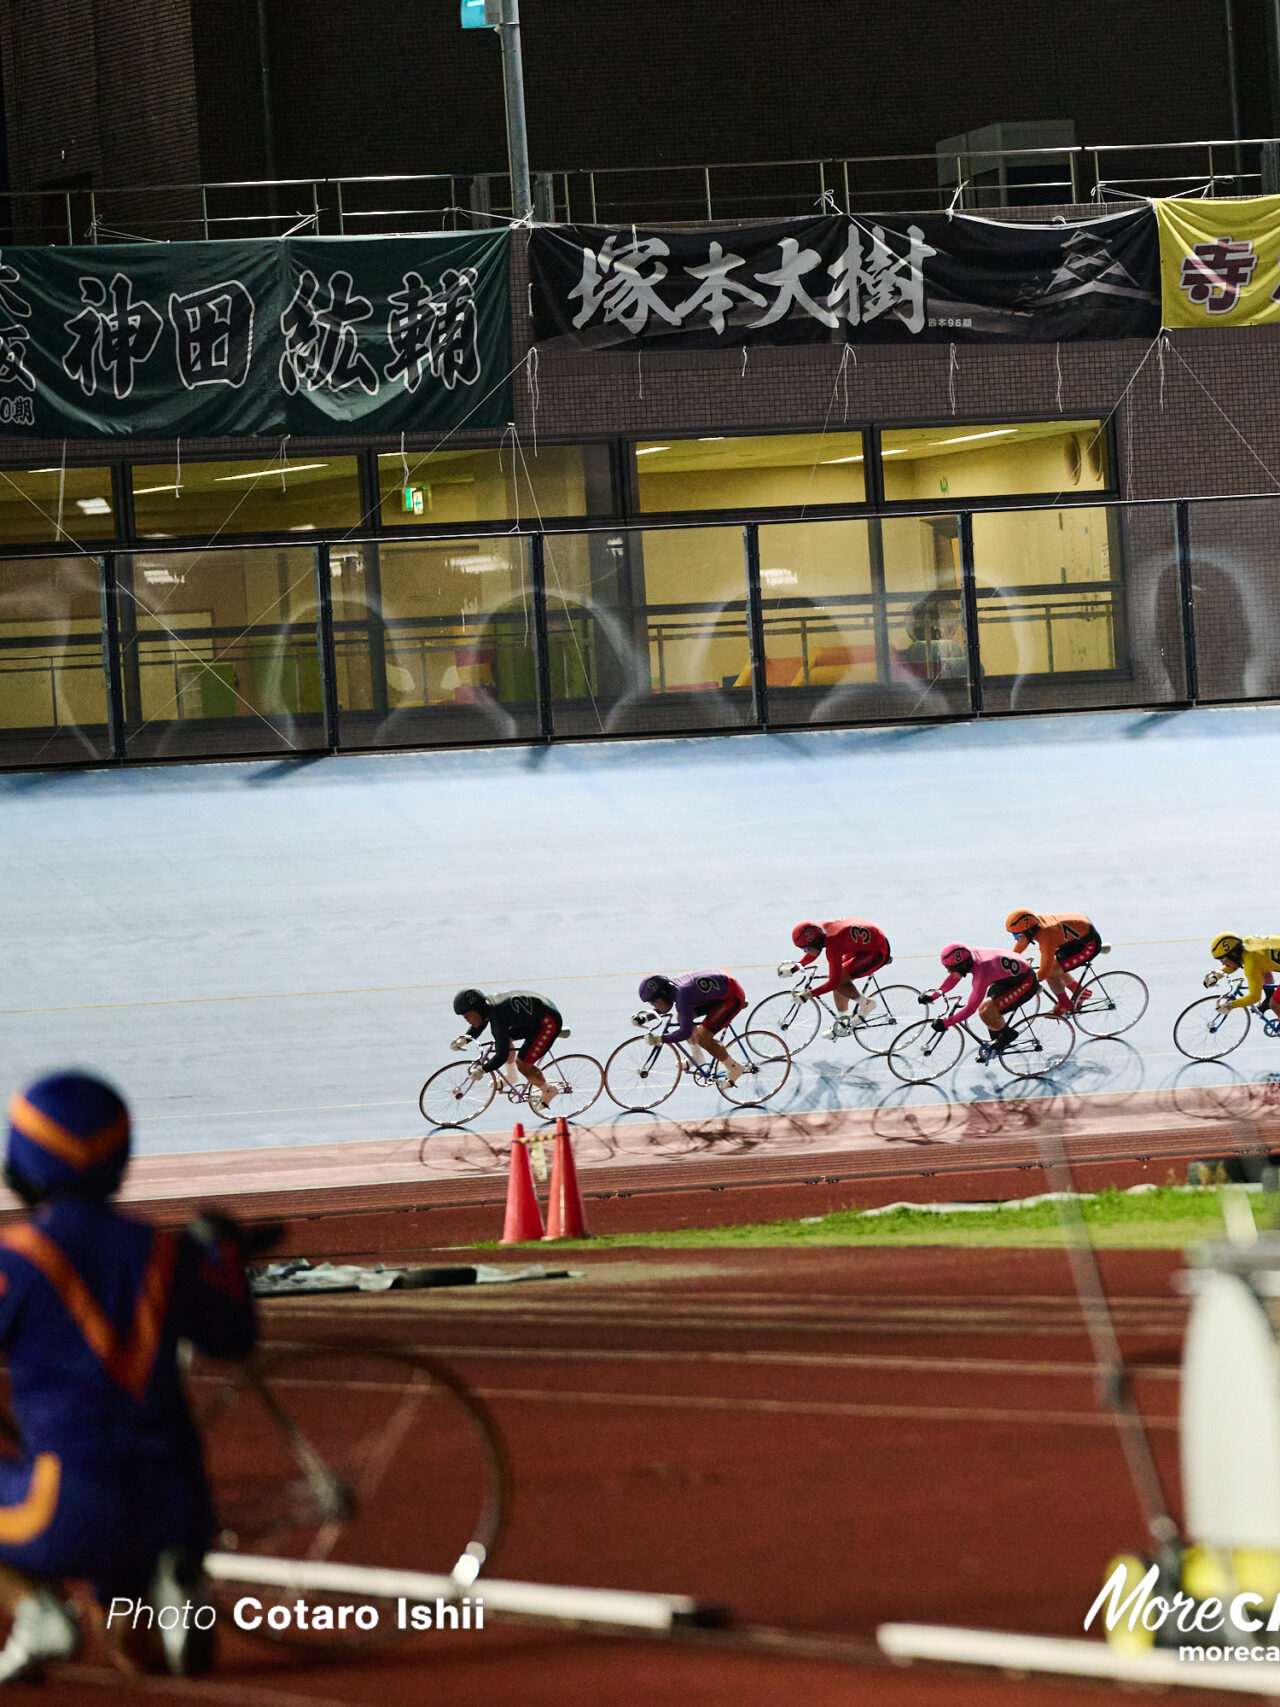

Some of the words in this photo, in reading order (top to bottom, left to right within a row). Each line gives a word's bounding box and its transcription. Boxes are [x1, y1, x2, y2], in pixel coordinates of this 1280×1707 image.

[567, 224, 936, 334] 塚本大樹
[62, 267, 481, 399] 神田紘輔
[849, 925, 872, 945] 3
[1060, 921, 1081, 941] 7
[1221, 940, 1231, 952] 5
[1000, 954, 1022, 977] 8
[696, 975, 720, 994] 9
[511, 994, 533, 1016] 2
